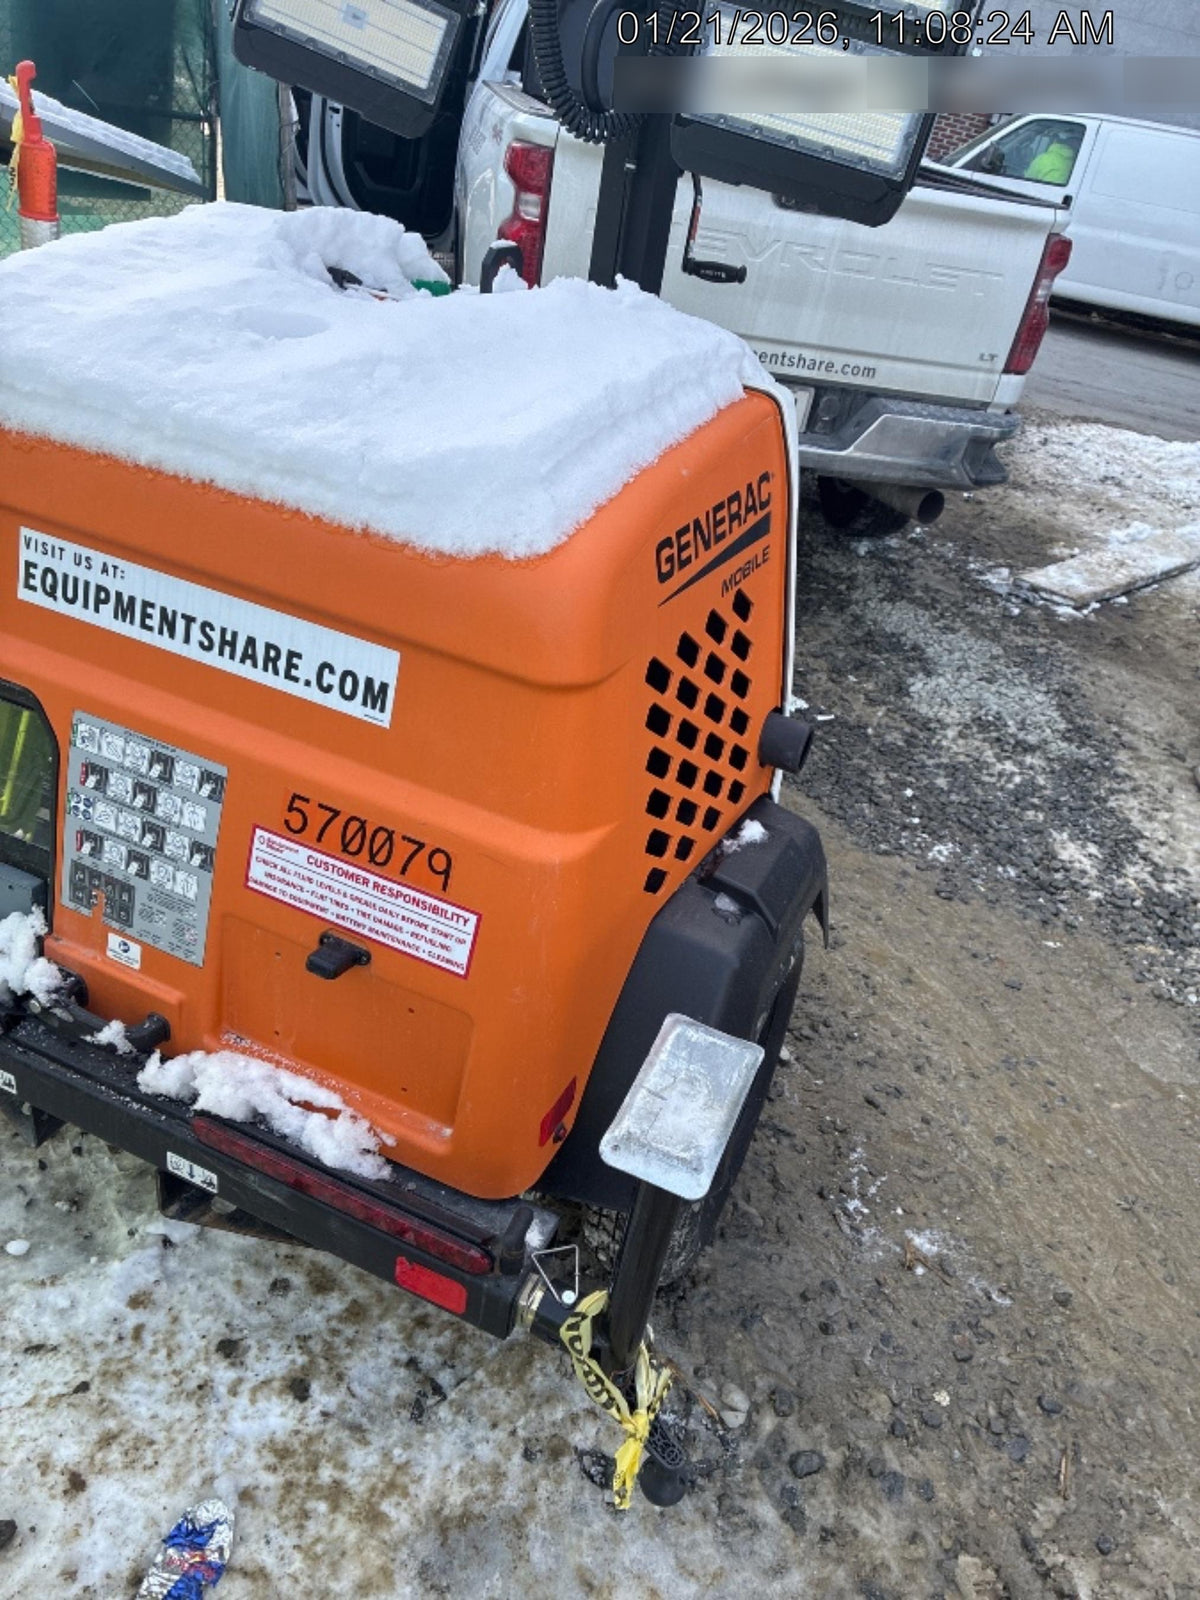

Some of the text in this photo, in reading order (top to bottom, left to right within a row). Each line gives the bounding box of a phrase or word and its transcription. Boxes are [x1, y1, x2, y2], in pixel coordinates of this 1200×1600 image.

[672, 221, 1004, 296] EVROLET
[753, 349, 877, 379] entshare.com
[24, 535, 126, 580] VISIT US AT:
[656, 470, 771, 584] GENERAC
[721, 545, 770, 598] MOBILE
[23, 560, 390, 713] EQUIPMENTSHARE.COM
[284, 793, 452, 893] 570079
[306, 853, 469, 927] CUSTOMER RESPONSIBILITY
